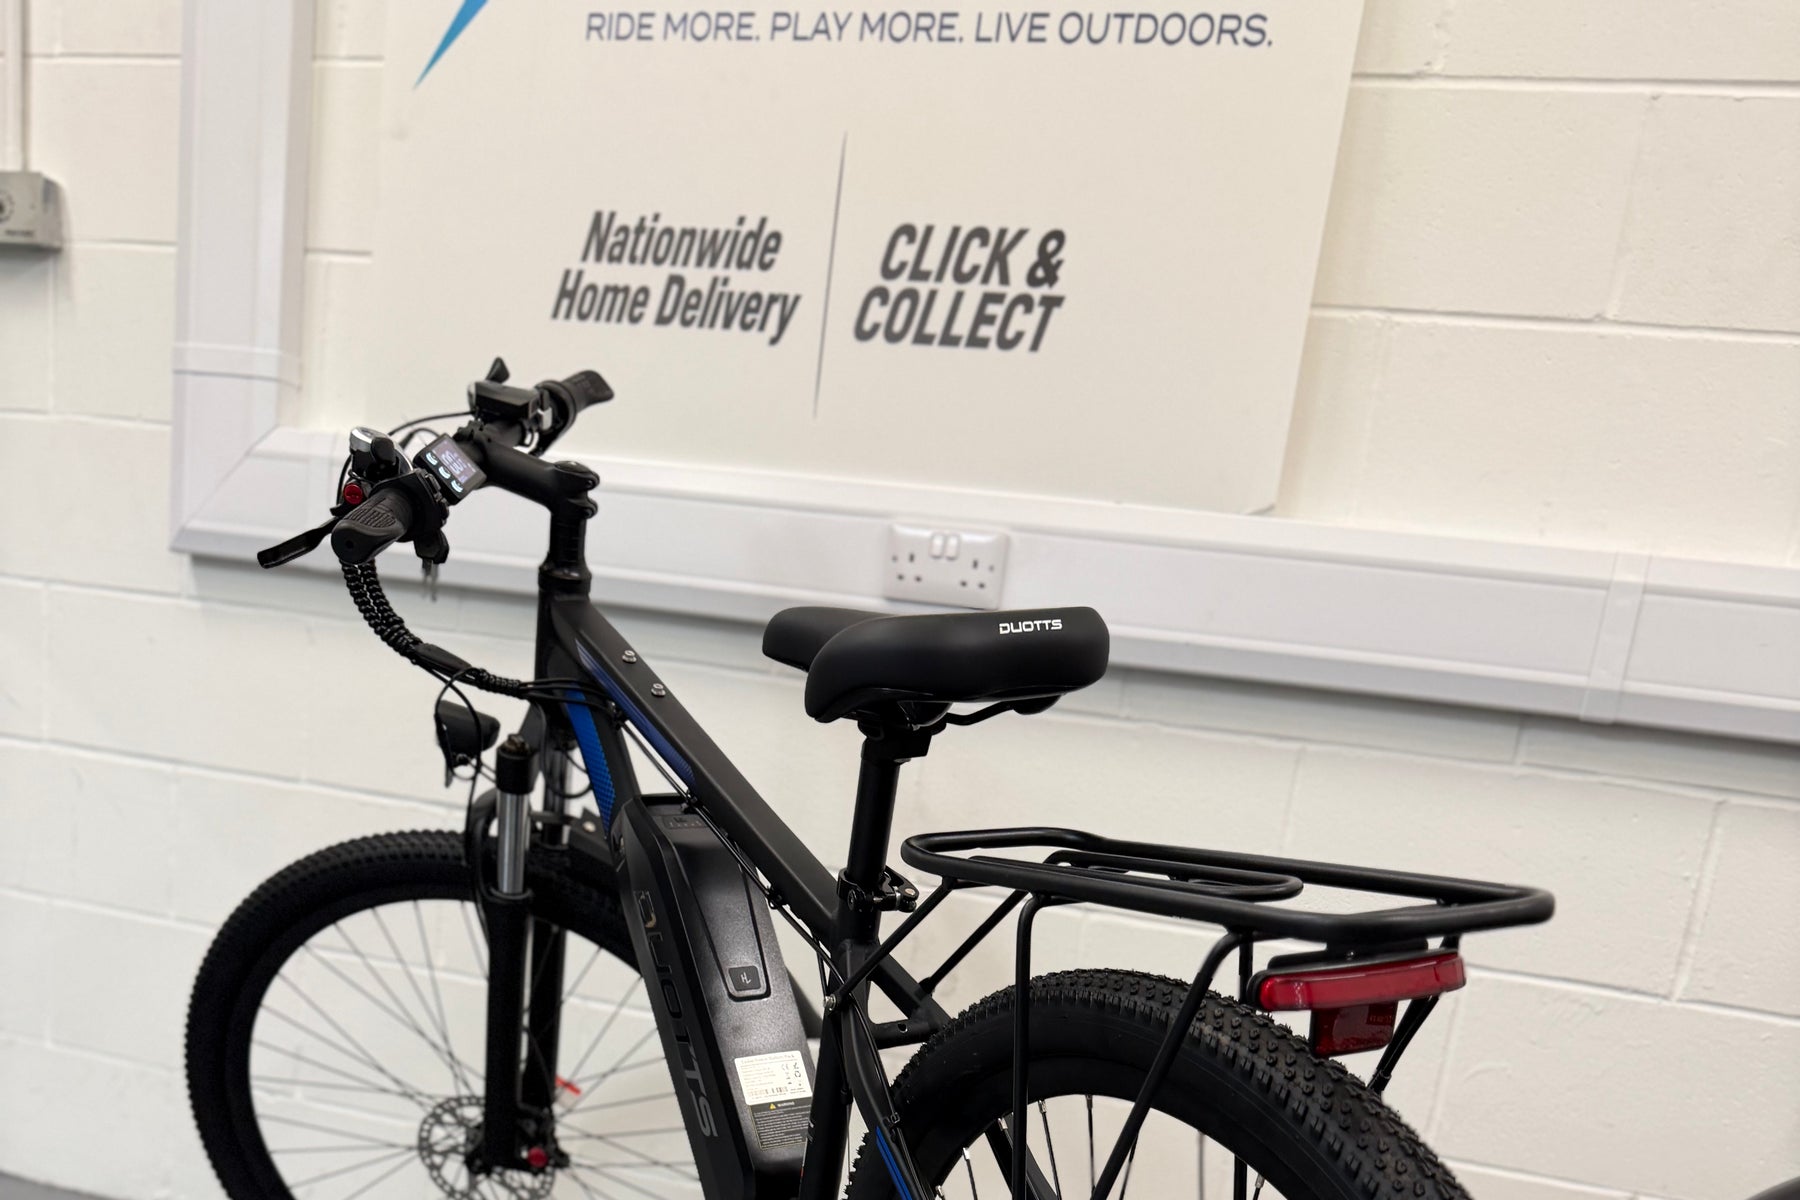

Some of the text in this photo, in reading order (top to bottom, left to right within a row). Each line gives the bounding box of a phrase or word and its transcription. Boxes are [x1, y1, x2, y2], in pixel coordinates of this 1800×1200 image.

[585, 11, 1273, 48] RIDE MORE. PLAY MORE. LIVE OUTDOORS.
[580, 209, 784, 273] Nationwide
[879, 222, 1067, 290] CLICK &
[550, 267, 803, 347] Home Delivery
[852, 284, 1067, 354] COLLECT
[998, 618, 1063, 635] DUOTTS
